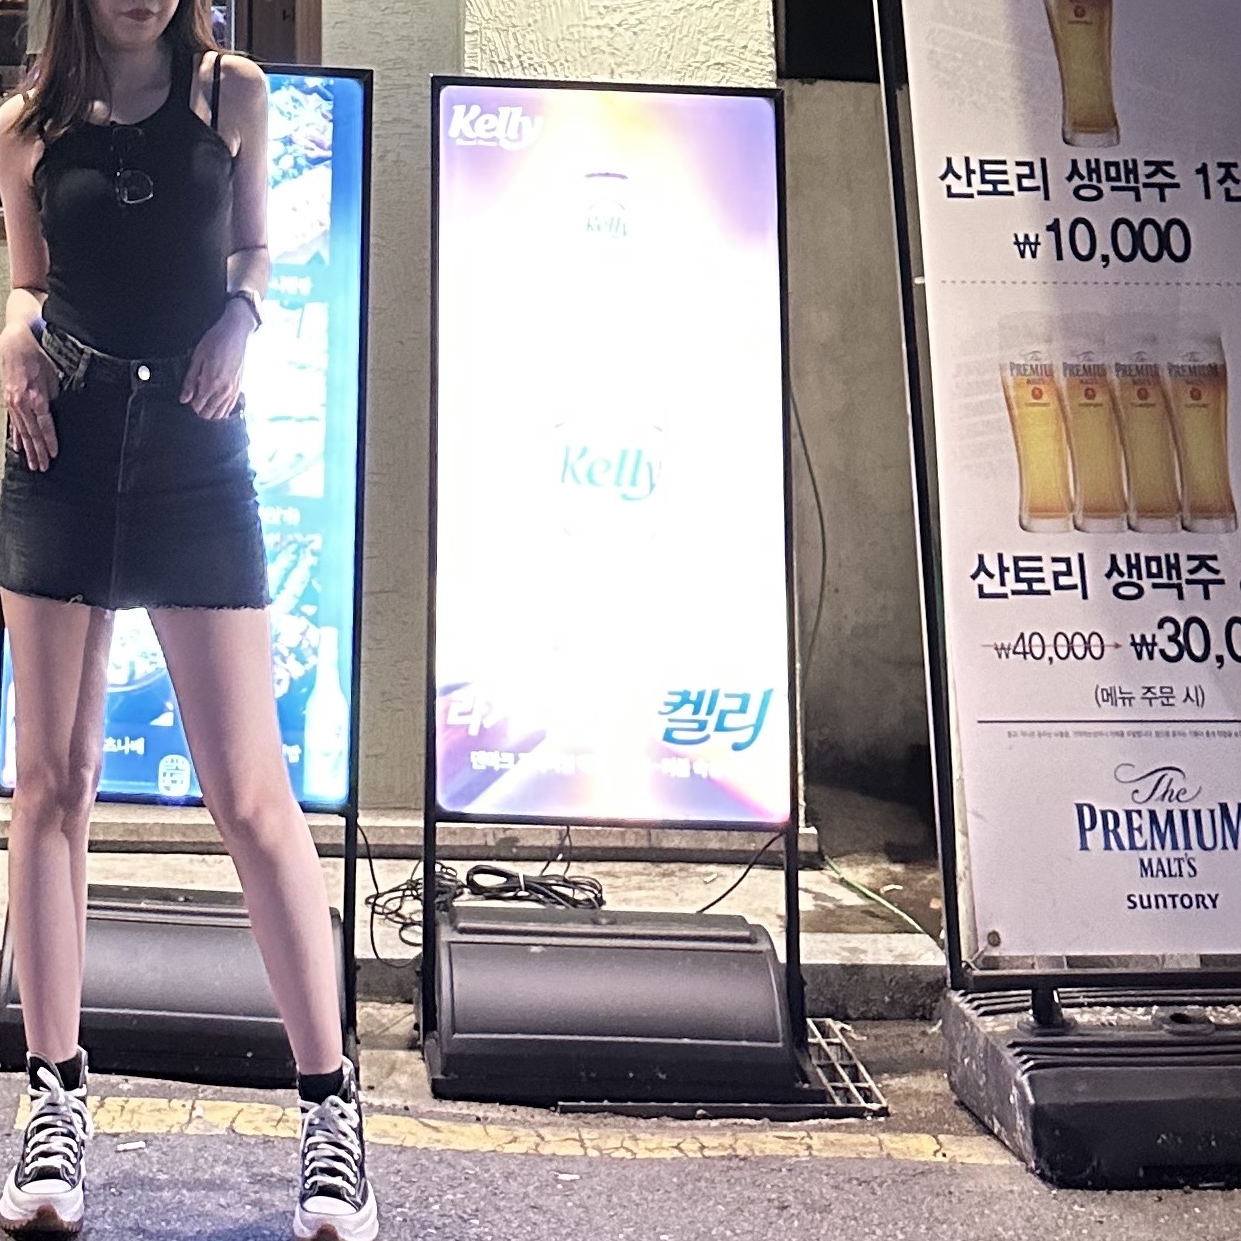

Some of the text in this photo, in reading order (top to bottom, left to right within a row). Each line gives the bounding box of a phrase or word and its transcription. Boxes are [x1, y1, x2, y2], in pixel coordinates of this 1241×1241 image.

[448, 105, 544, 151] Kelly
[939, 156, 1050, 201] 산토리
[1065, 157, 1181, 203] 생맥주
[1014, 217, 1192, 268] ₩10,000
[560, 444, 662, 501] Kelly
[970, 552, 1226, 601] 산토리 생맥주
[993, 631, 1105, 666] ₩40,000
[1094, 684, 1205, 708] (메뉴 주문 시)
[657, 688, 774, 751] 켈리
[1114, 763, 1202, 804] The
[1139, 852, 1198, 878] MALT'S
